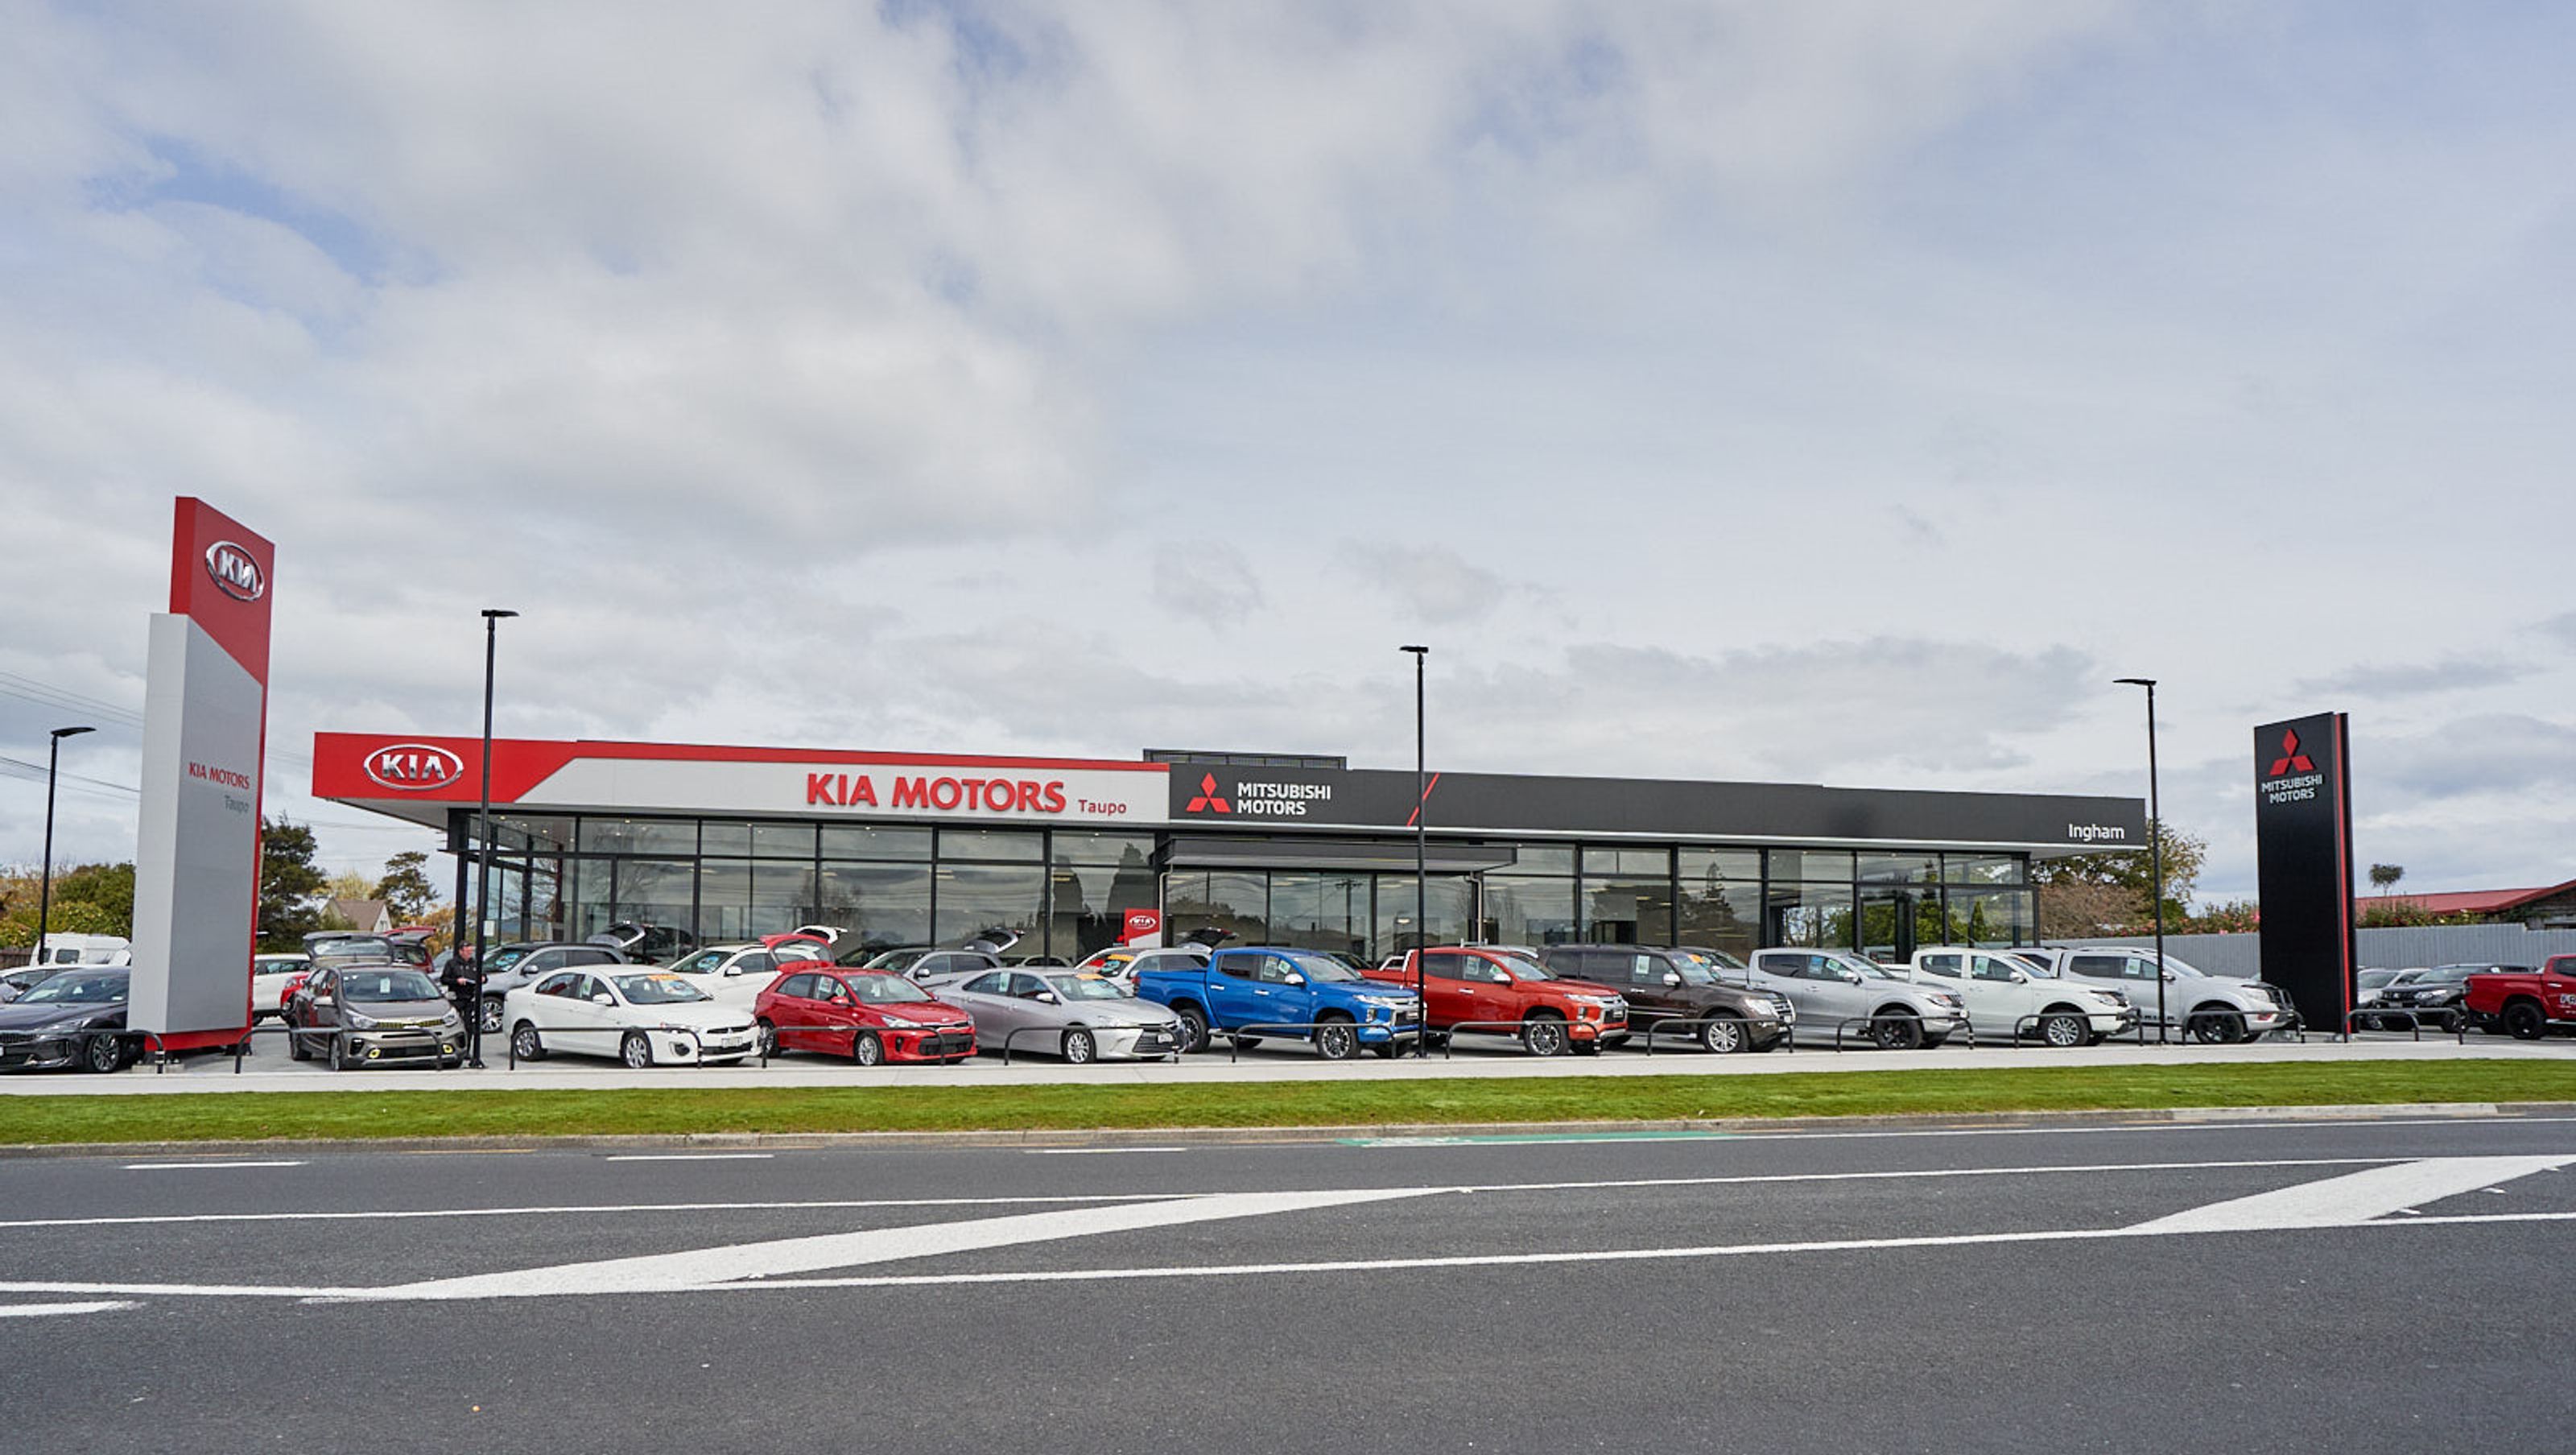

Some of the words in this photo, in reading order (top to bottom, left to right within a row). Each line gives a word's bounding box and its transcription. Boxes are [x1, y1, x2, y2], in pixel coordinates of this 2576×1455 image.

[219, 549, 257, 593] KIA
[189, 761, 207, 779] KIA
[209, 766, 250, 790] MOTORS
[382, 754, 446, 779] KIA
[1237, 782, 1331, 800] MITSUBISHI
[2261, 773, 2323, 794] MITSUBISHI
[807, 773, 878, 807] KIA
[891, 776, 1067, 813] MOTORS
[1079, 799, 1127, 816] Taupo
[2269, 787, 2316, 804] MOTORS
[1237, 799, 1307, 816] MOTORS
[2068, 823, 2125, 842] Ingham
